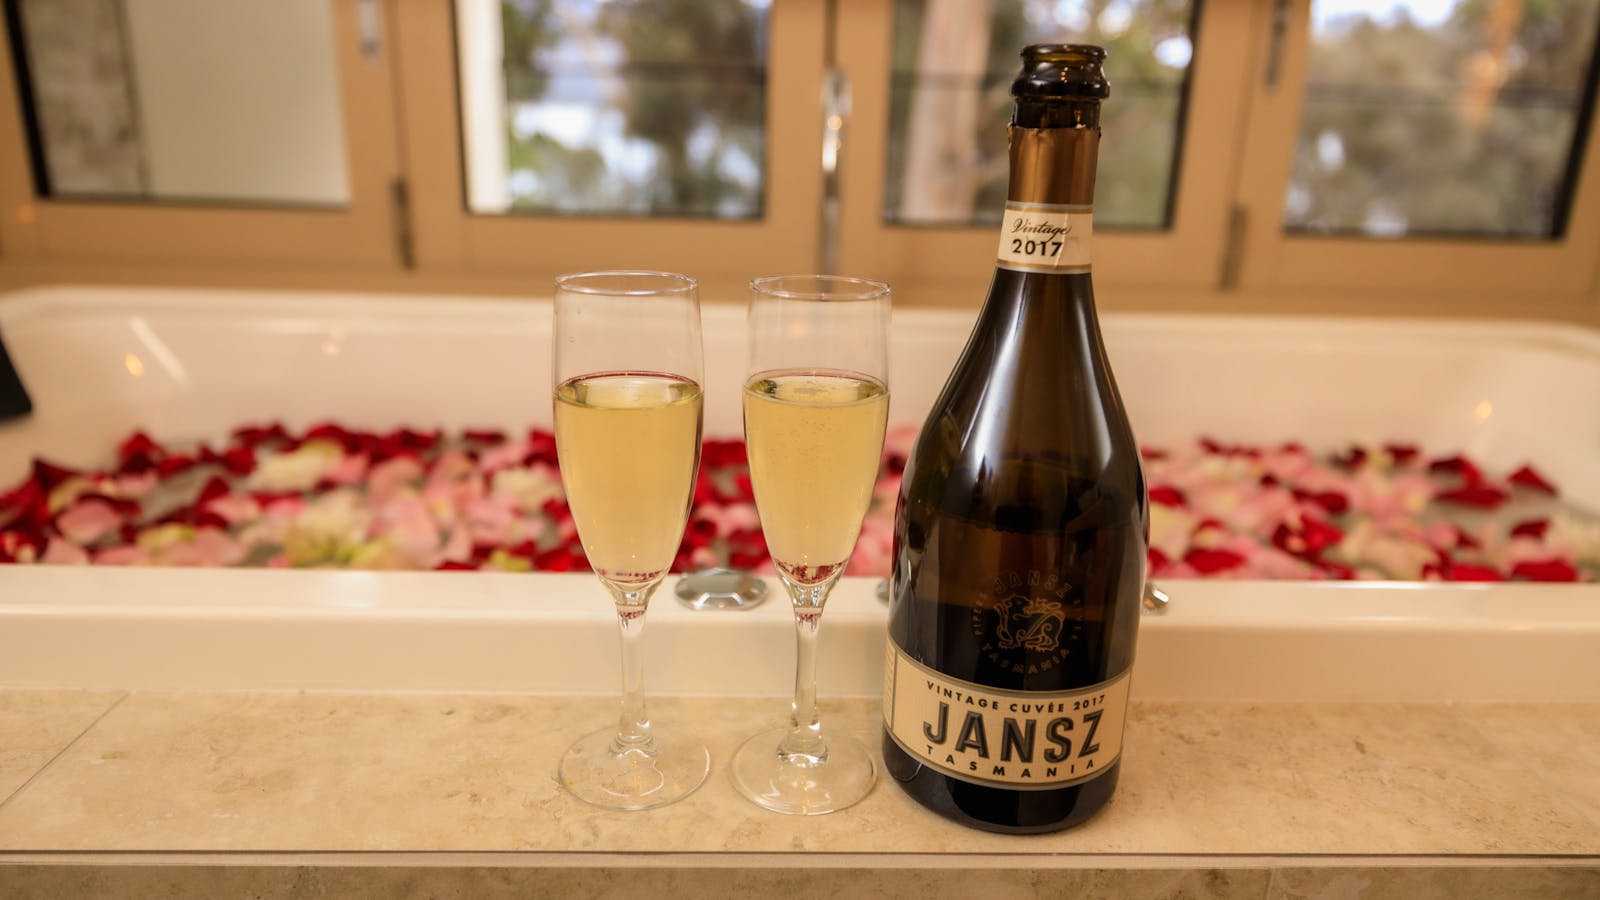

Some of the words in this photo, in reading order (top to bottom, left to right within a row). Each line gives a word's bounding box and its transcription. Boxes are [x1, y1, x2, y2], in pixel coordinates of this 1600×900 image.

[1011, 218, 1072, 246] Vintage
[1012, 238, 1063, 257] 2017
[993, 569, 1073, 600] JANSZ
[926, 679, 999, 710] VINTAGE
[1009, 701, 1065, 714] CUVÉE
[1073, 694, 1106, 711] 2017
[922, 700, 1105, 764] JANSZ
[926, 744, 1094, 778] TASMANIA
